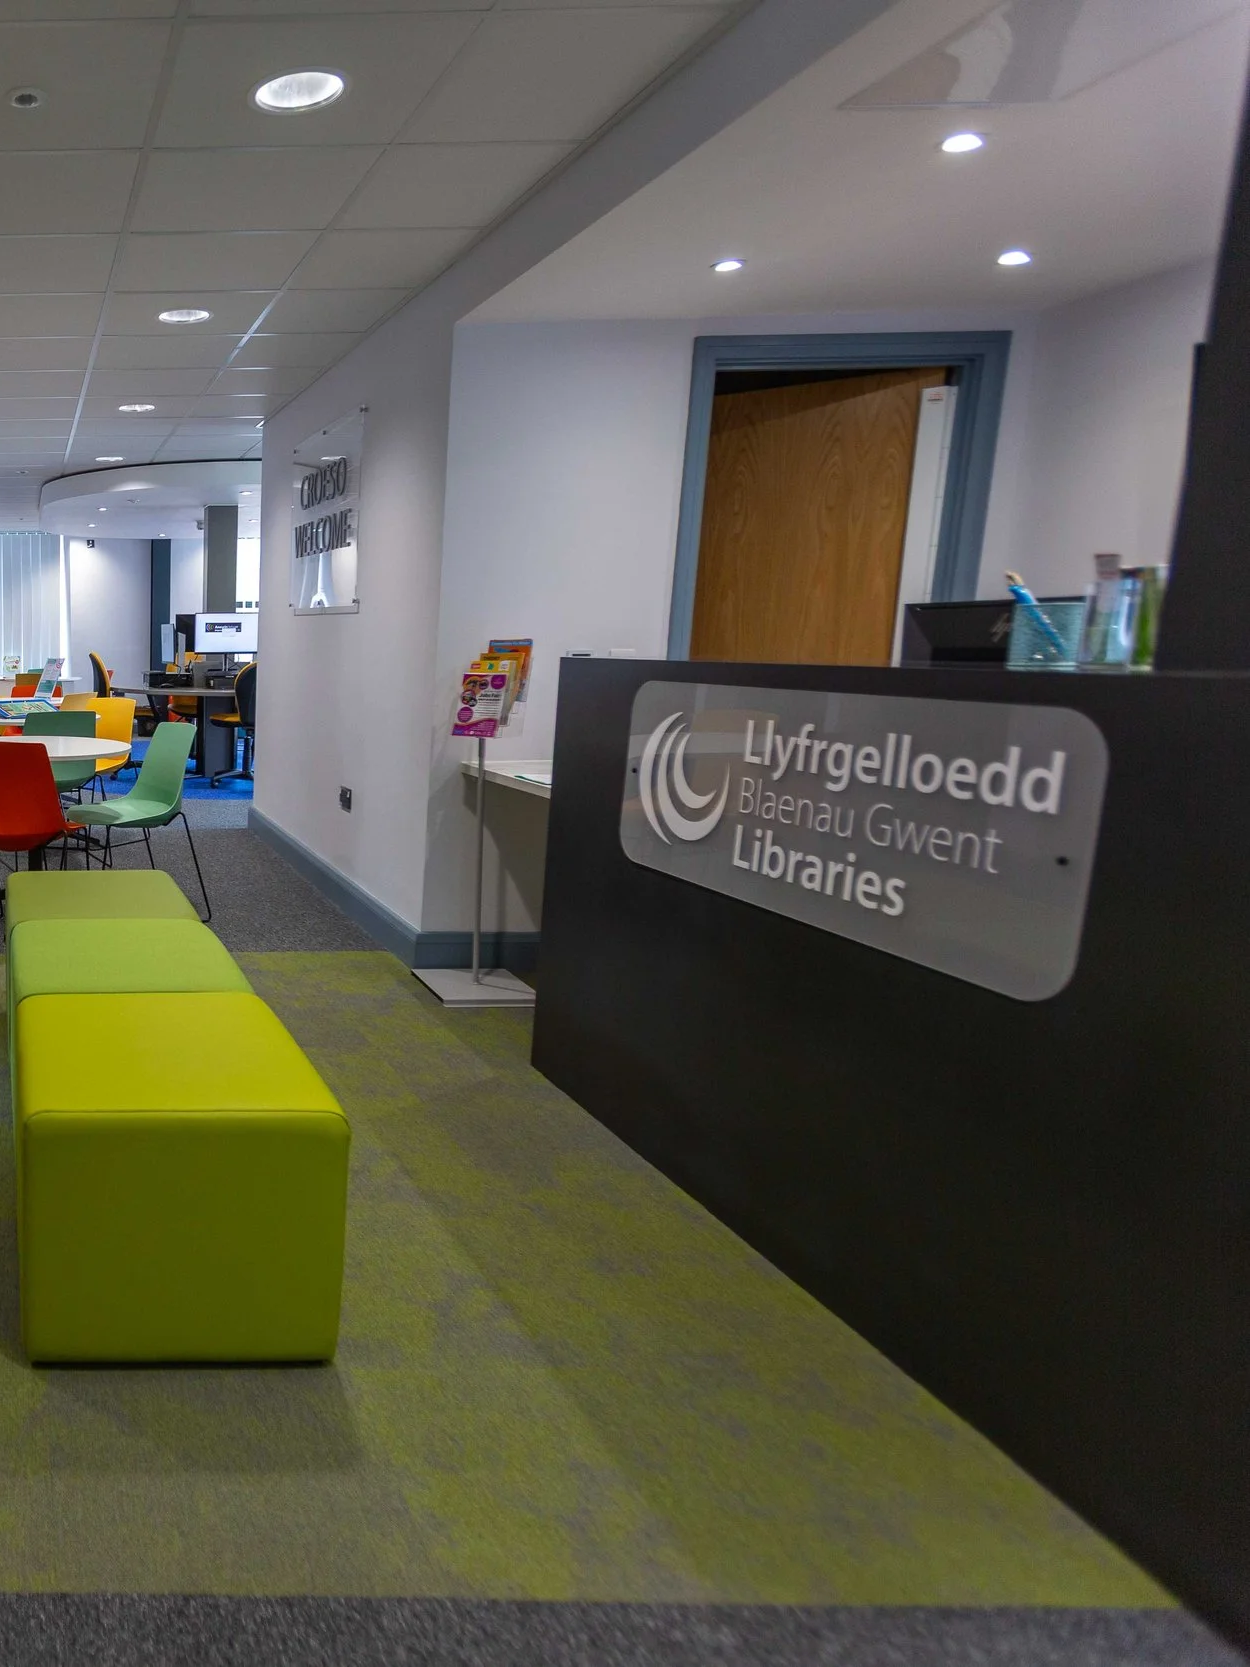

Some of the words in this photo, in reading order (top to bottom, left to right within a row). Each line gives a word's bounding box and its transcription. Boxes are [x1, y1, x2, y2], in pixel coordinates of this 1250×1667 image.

[300, 457, 347, 511] CROESO
[295, 508, 352, 559] WELCOME
[744, 719, 1067, 815] Llyfrgelloedd
[733, 824, 907, 917] Libraries
[739, 777, 854, 838] Blaenau
[865, 803, 1004, 874] Gwent
